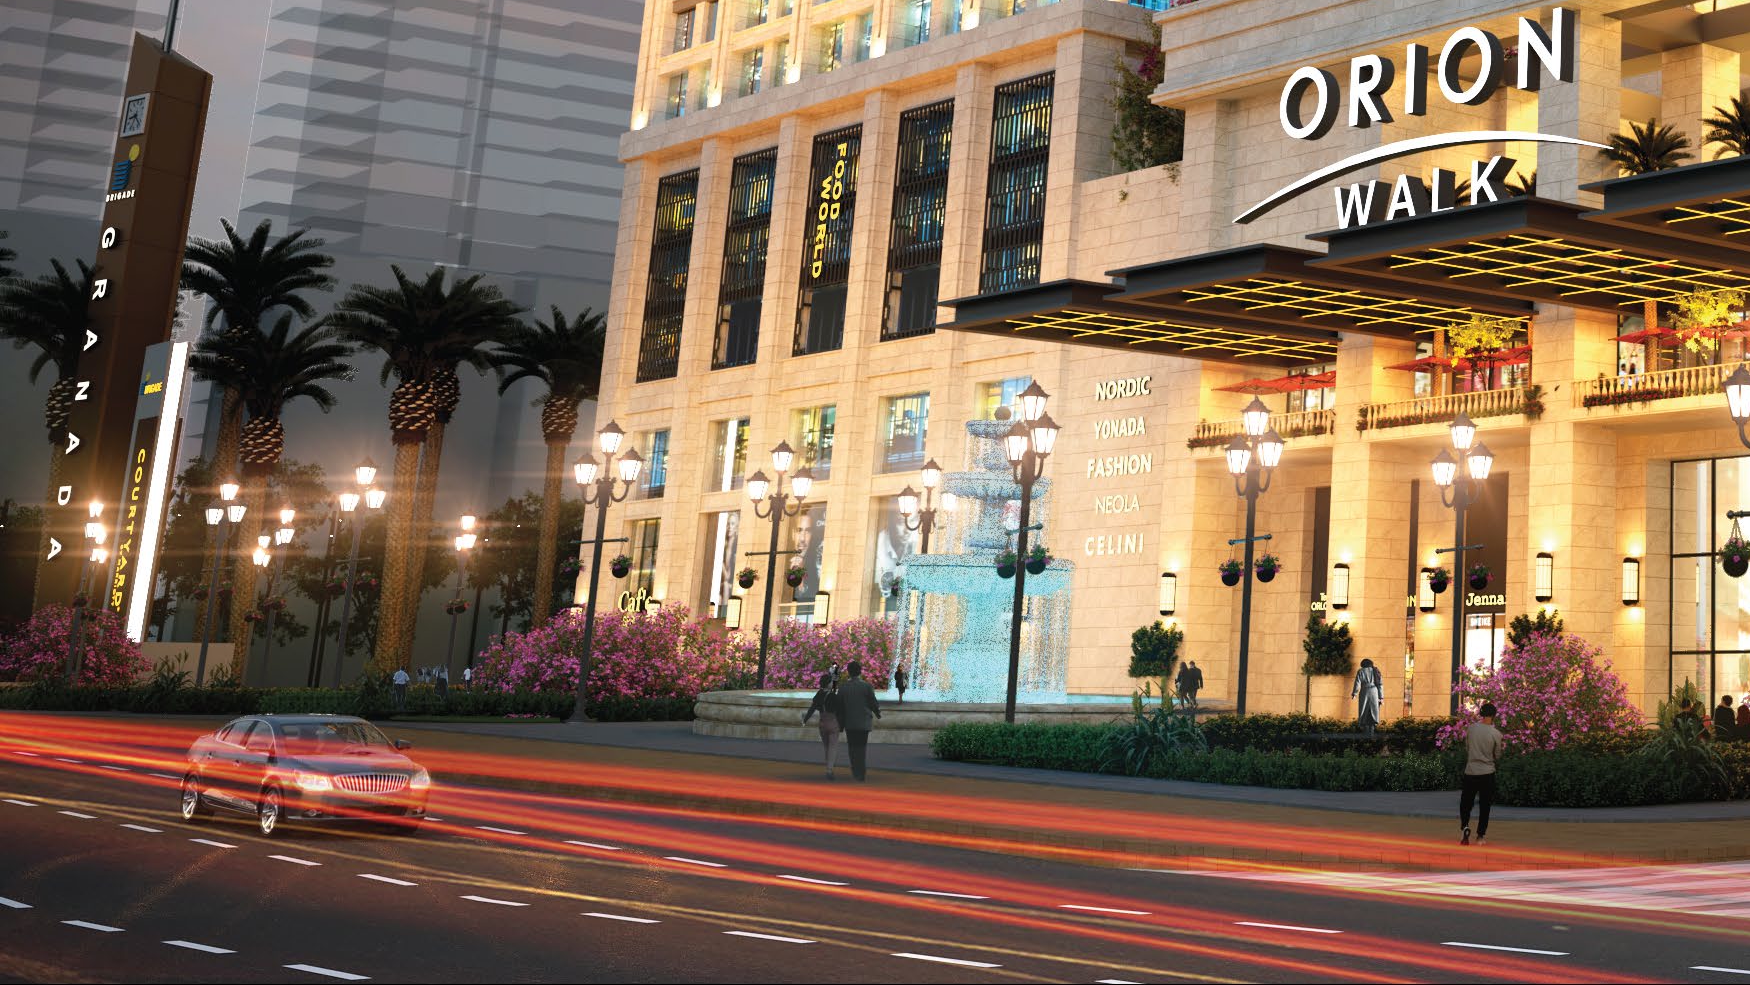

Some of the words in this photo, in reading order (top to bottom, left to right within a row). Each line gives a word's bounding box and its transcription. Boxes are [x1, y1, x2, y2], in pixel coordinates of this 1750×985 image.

[1280, 6, 1566, 140] ORION
[830, 142, 848, 220] FOOD
[1334, 155, 1502, 229] WALK
[105, 189, 136, 203] BRIGADE
[812, 175, 833, 279] WORLD
[47, 226, 116, 561] GRANADA
[1095, 375, 1151, 401] NORDIC
[1094, 415, 1146, 440] YONADA
[1087, 452, 1153, 479] FASHION
[1094, 494, 1141, 515] NEOLA
[1084, 532, 1145, 557] CELINI
[1465, 592, 1506, 607] Jenna
